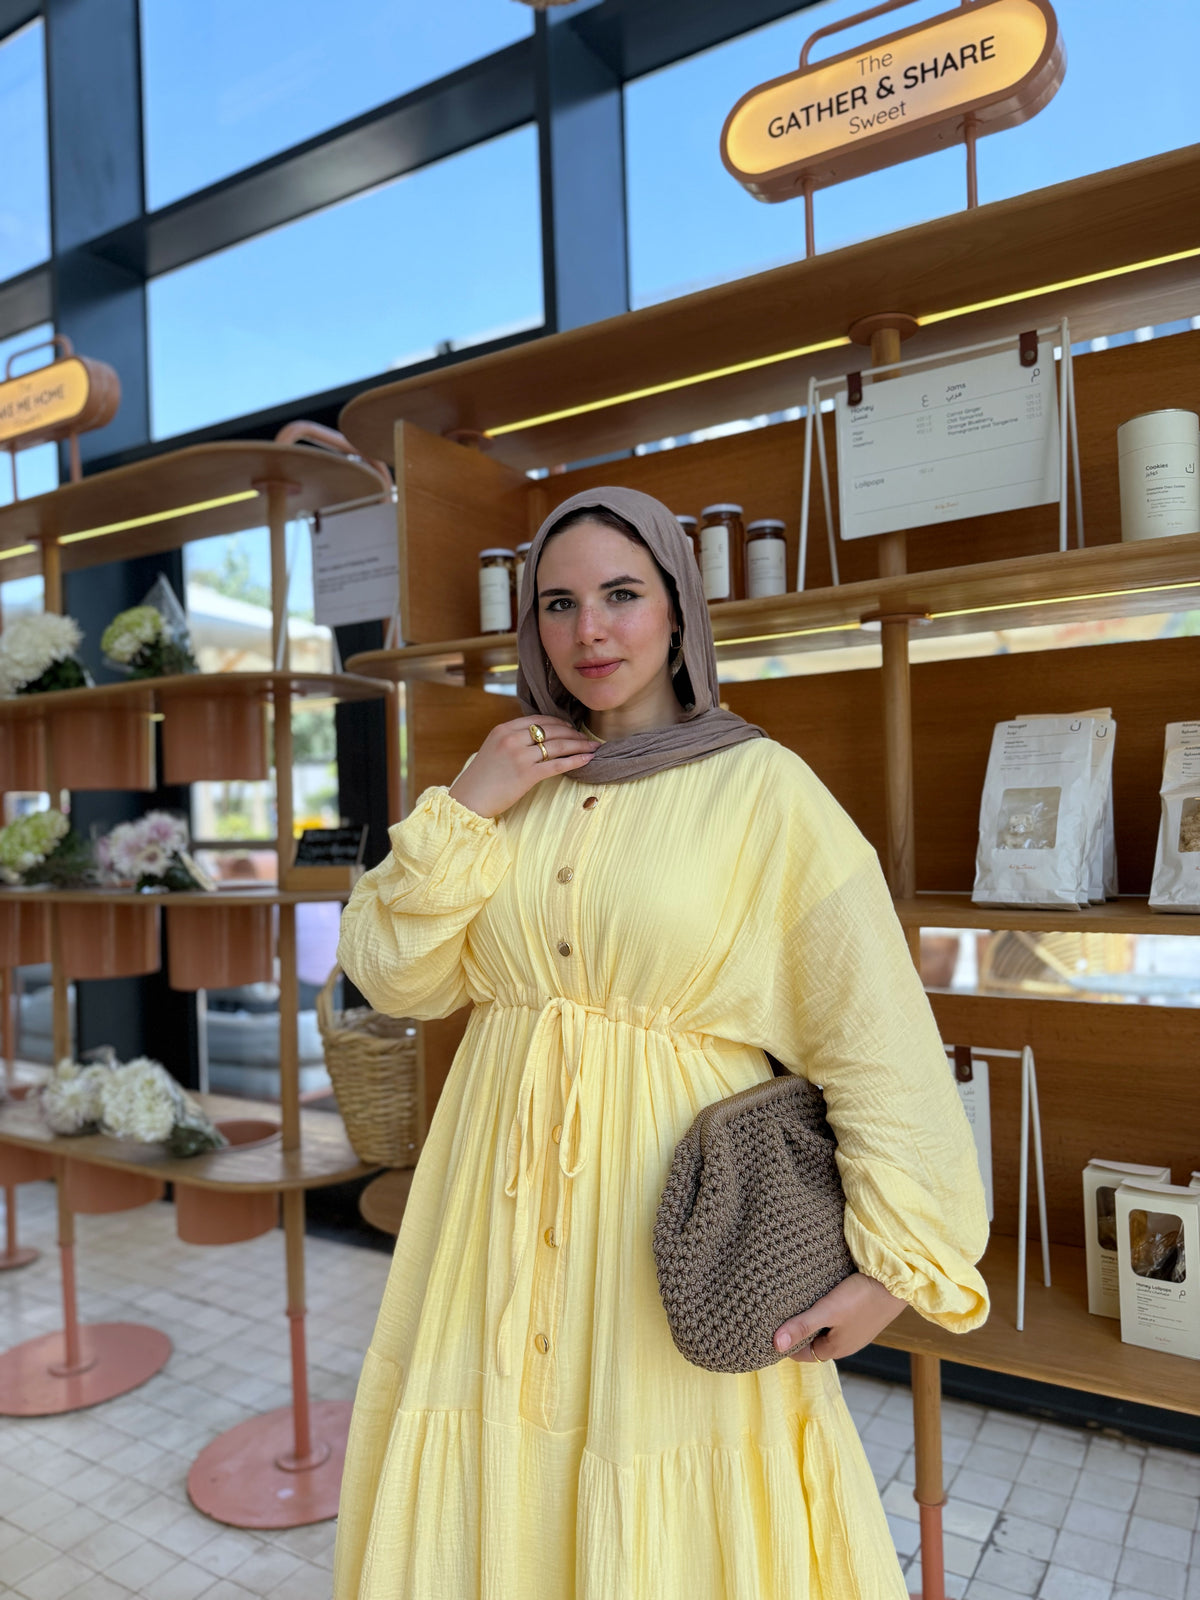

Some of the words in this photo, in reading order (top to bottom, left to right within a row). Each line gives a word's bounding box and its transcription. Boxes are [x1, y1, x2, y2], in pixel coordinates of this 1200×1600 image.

[857, 52, 893, 77] The
[767, 85, 868, 139] GATHER
[876, 76, 895, 99] &
[903, 35, 996, 89] SHARE
[849, 101, 907, 135] Sweet
[945, 382, 966, 393] Jams
[1145, 463, 1168, 471] Cookies
